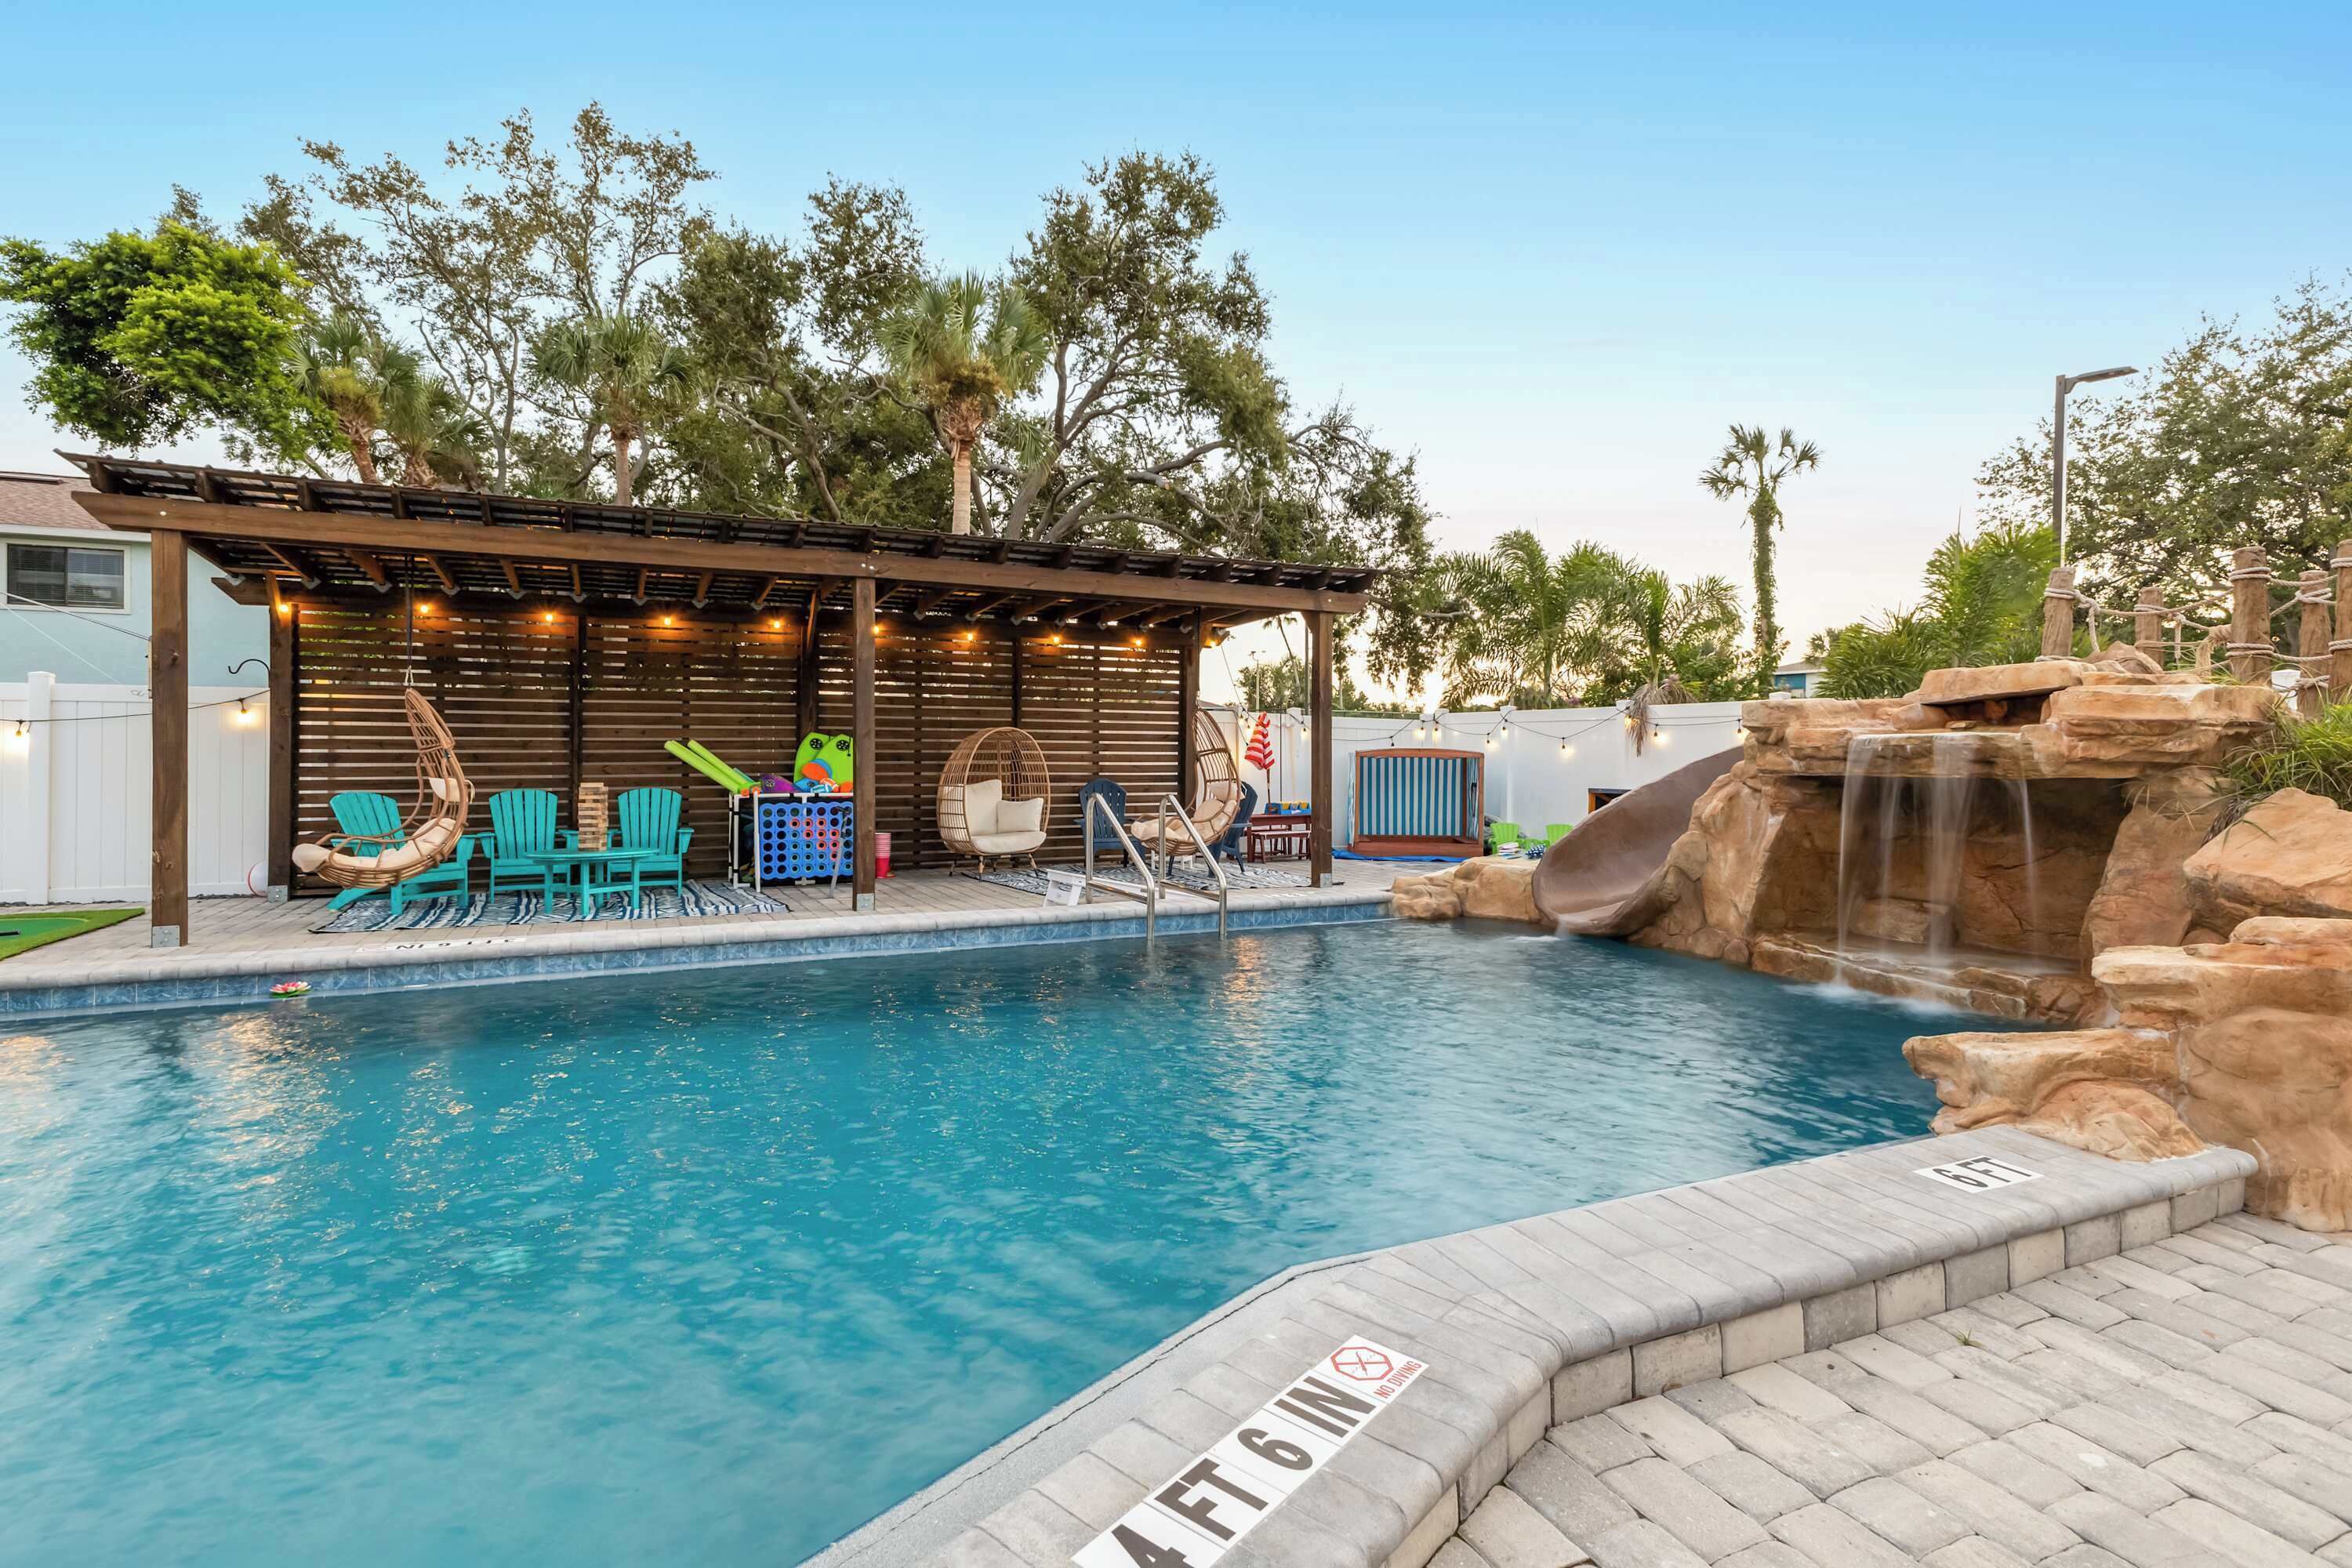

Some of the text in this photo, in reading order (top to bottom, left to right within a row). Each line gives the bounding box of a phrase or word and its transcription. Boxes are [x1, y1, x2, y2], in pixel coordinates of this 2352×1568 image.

[1932, 1156, 2032, 1188] 6 FT
[1374, 1360, 1422, 1399] NO DIVING
[1111, 1375, 1377, 1568] 4 FT 6 IN
